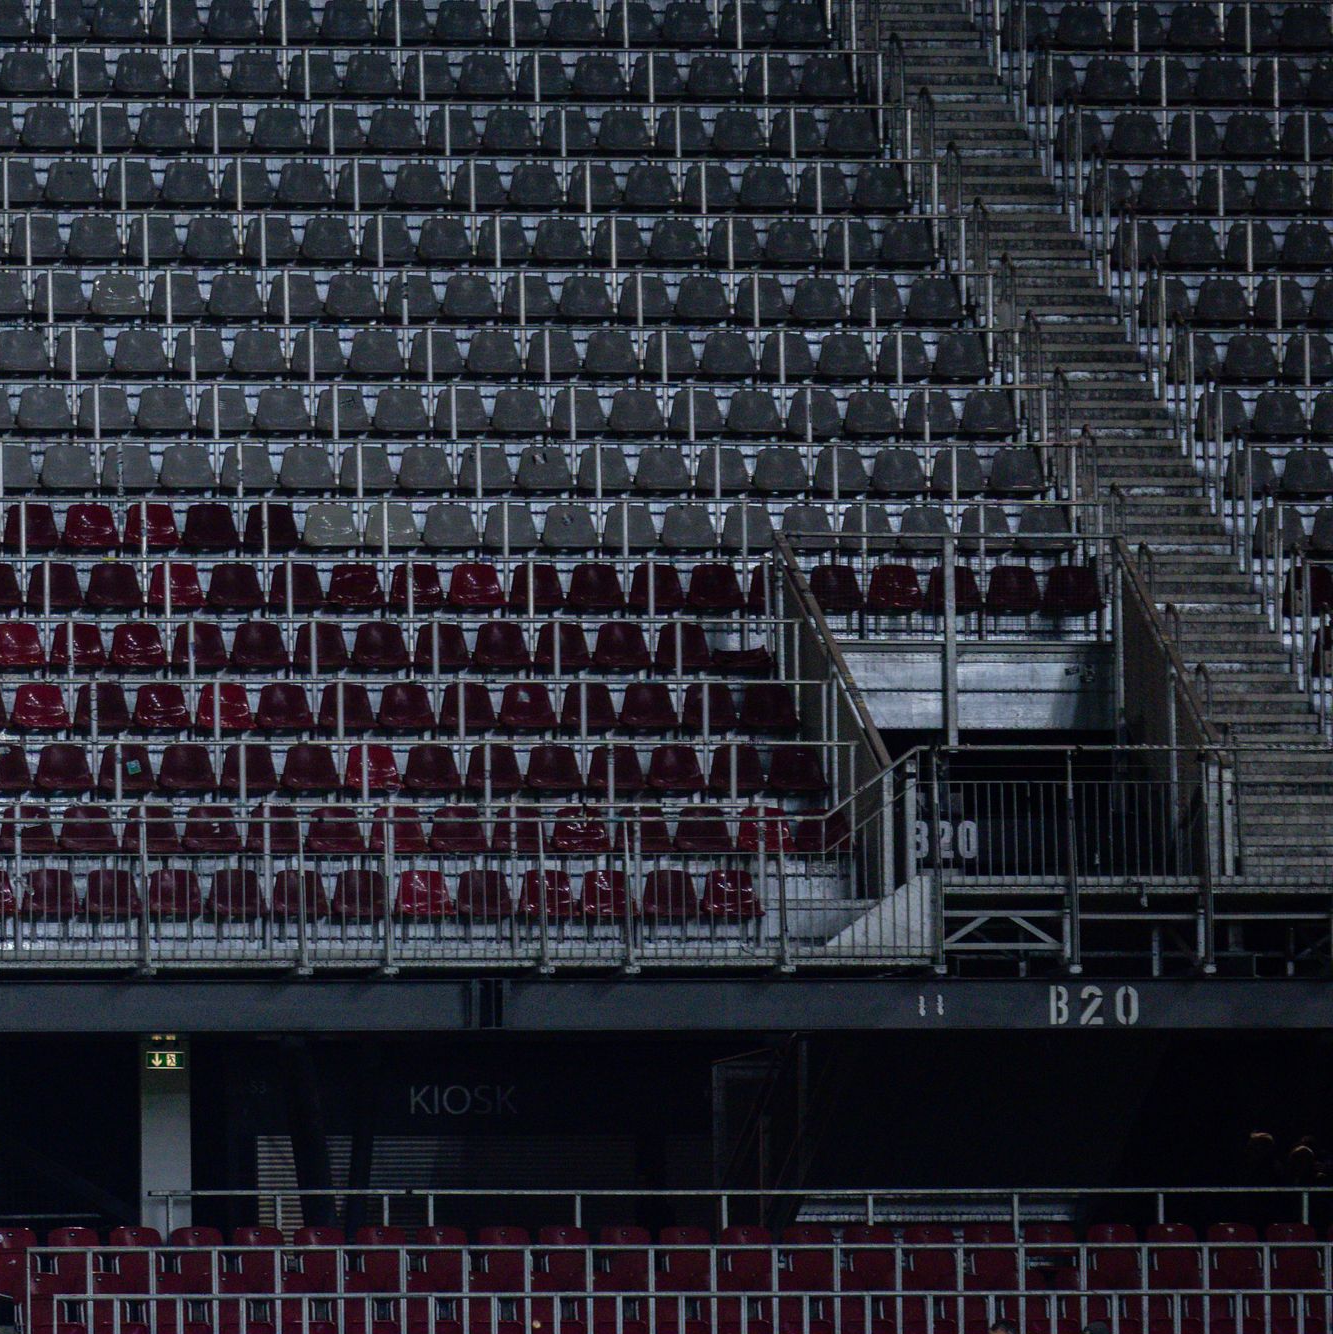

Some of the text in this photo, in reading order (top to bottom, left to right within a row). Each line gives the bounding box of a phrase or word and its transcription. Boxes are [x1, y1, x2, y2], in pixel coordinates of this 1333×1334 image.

[915, 820, 978, 859] B20
[1049, 985, 1139, 1025] B20
[409, 1085, 517, 1116] KIOSK
